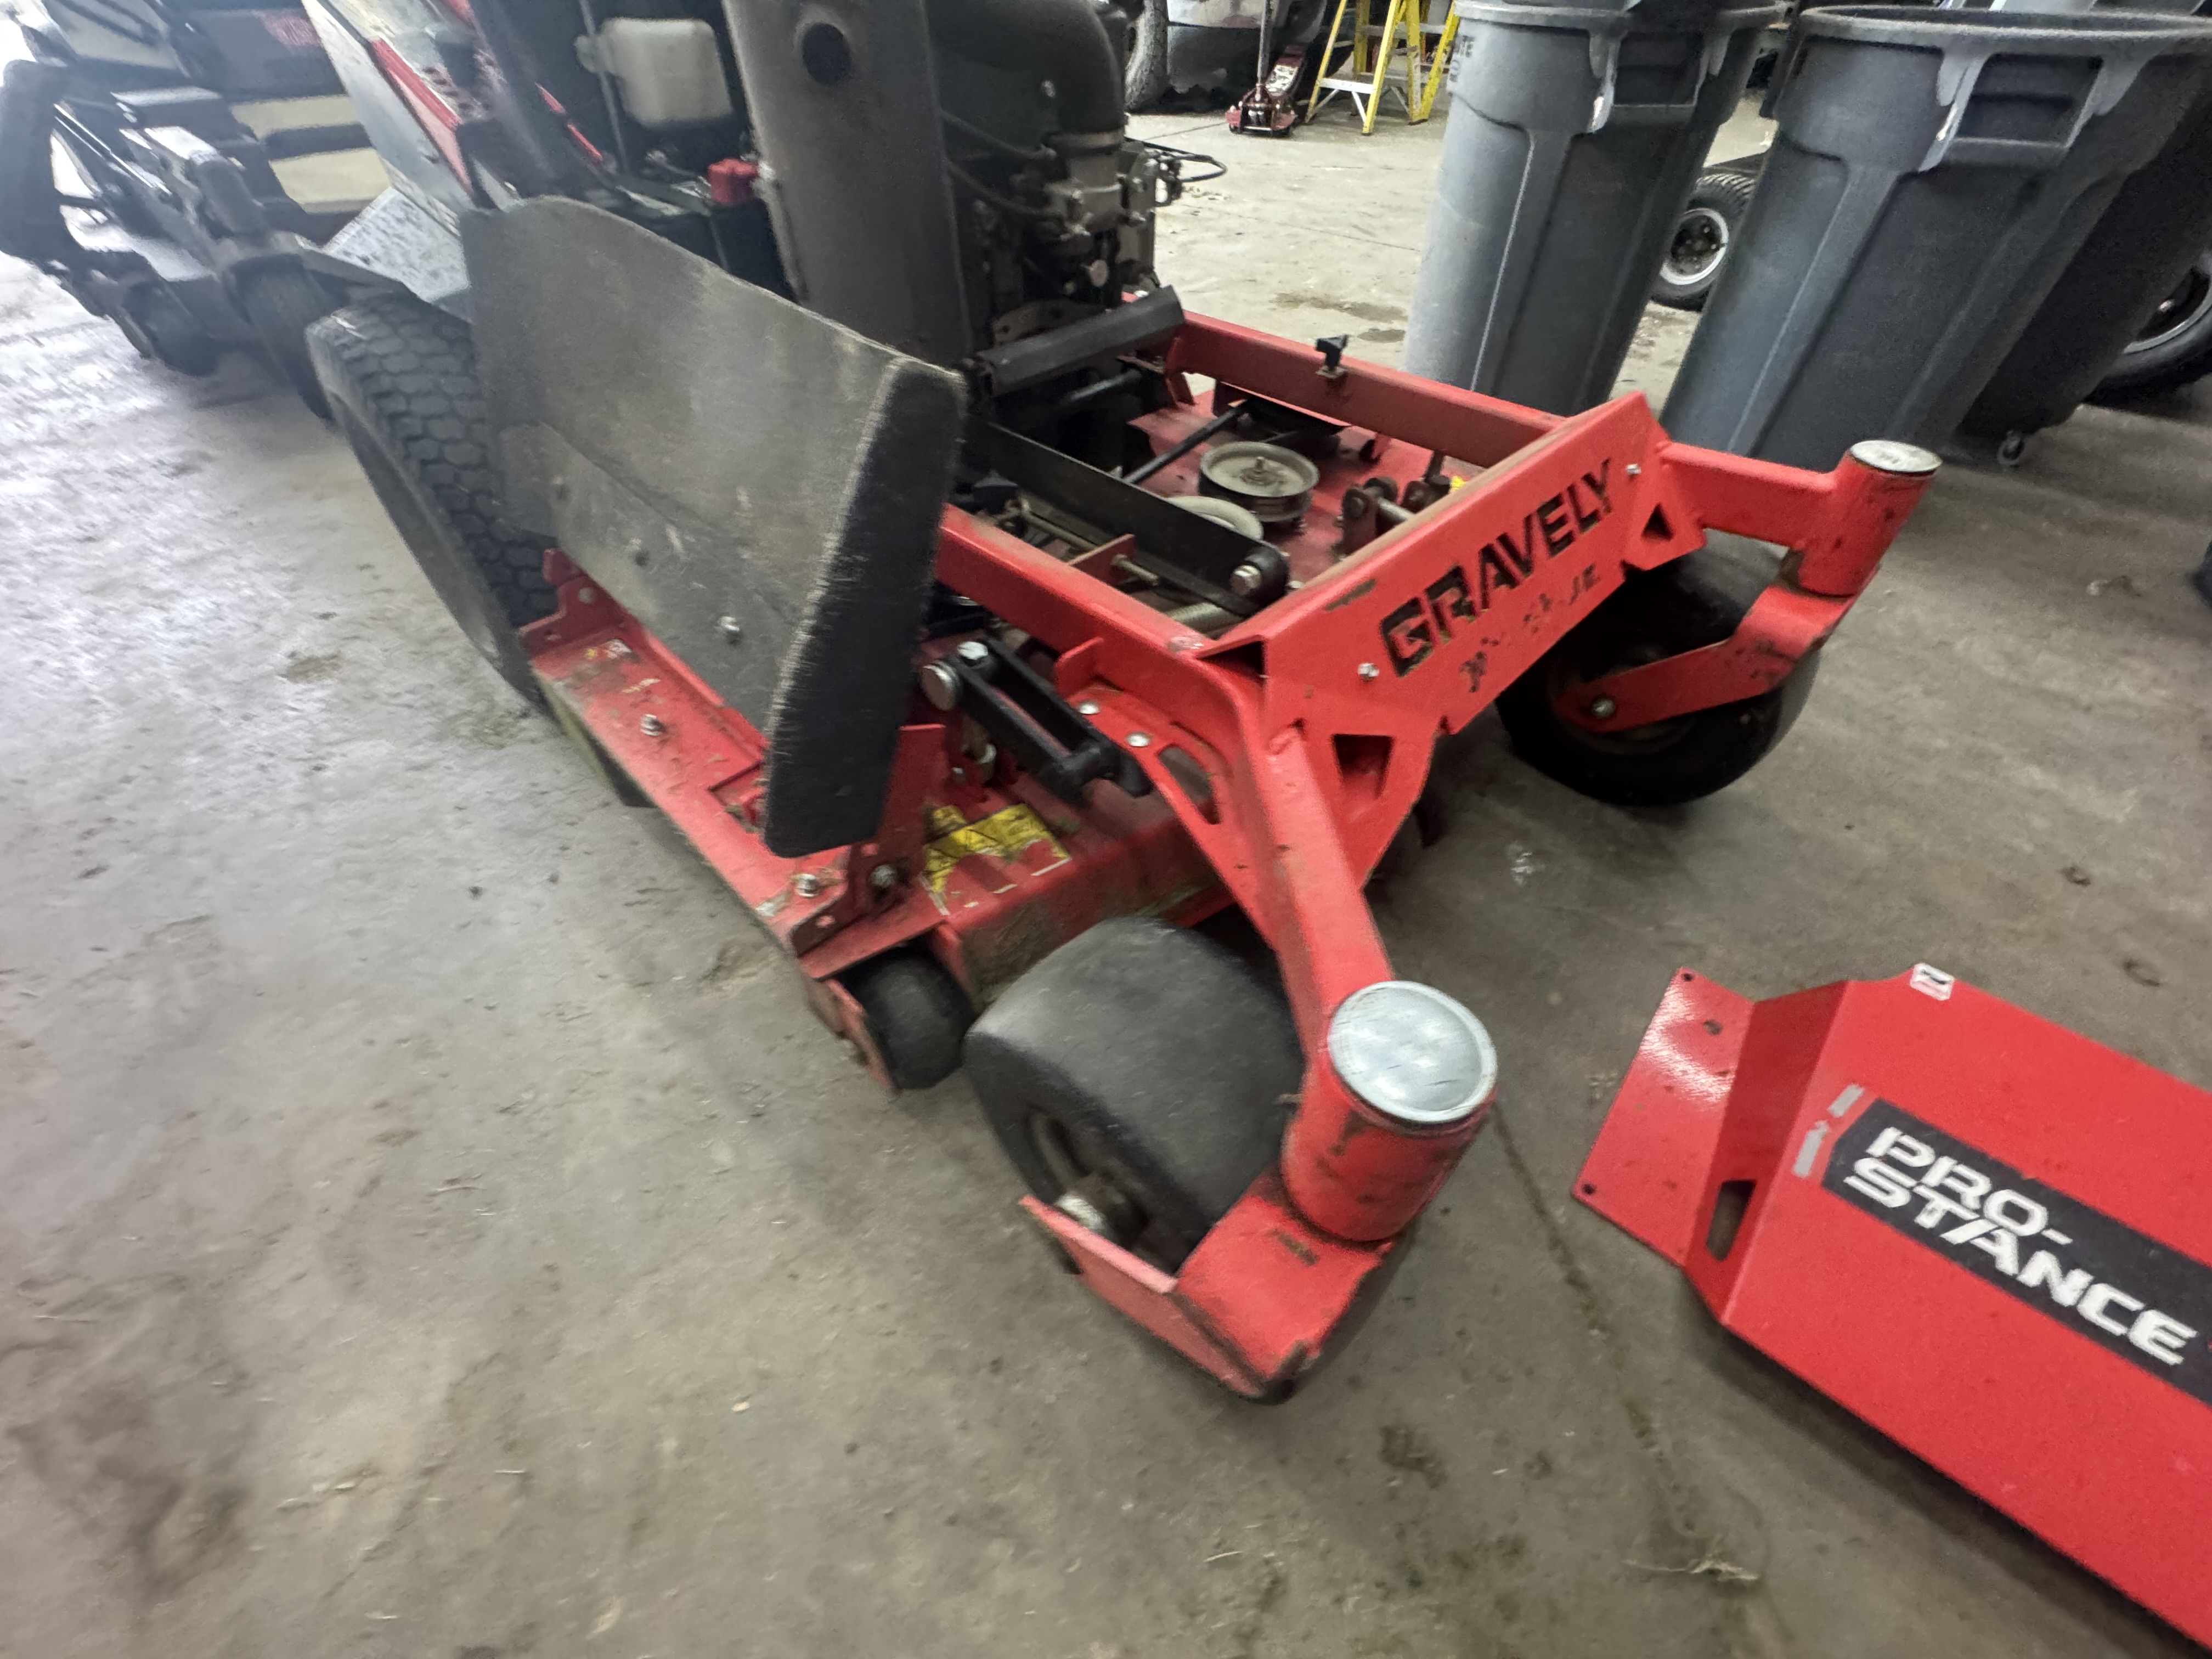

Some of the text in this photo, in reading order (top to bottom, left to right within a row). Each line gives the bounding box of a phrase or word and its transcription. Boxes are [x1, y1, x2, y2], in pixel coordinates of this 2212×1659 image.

[1380, 458, 1612, 678] GRAVELY
[1843, 1156, 2199, 1365] STANCE
[1866, 1126, 2074, 1246] PRO-
